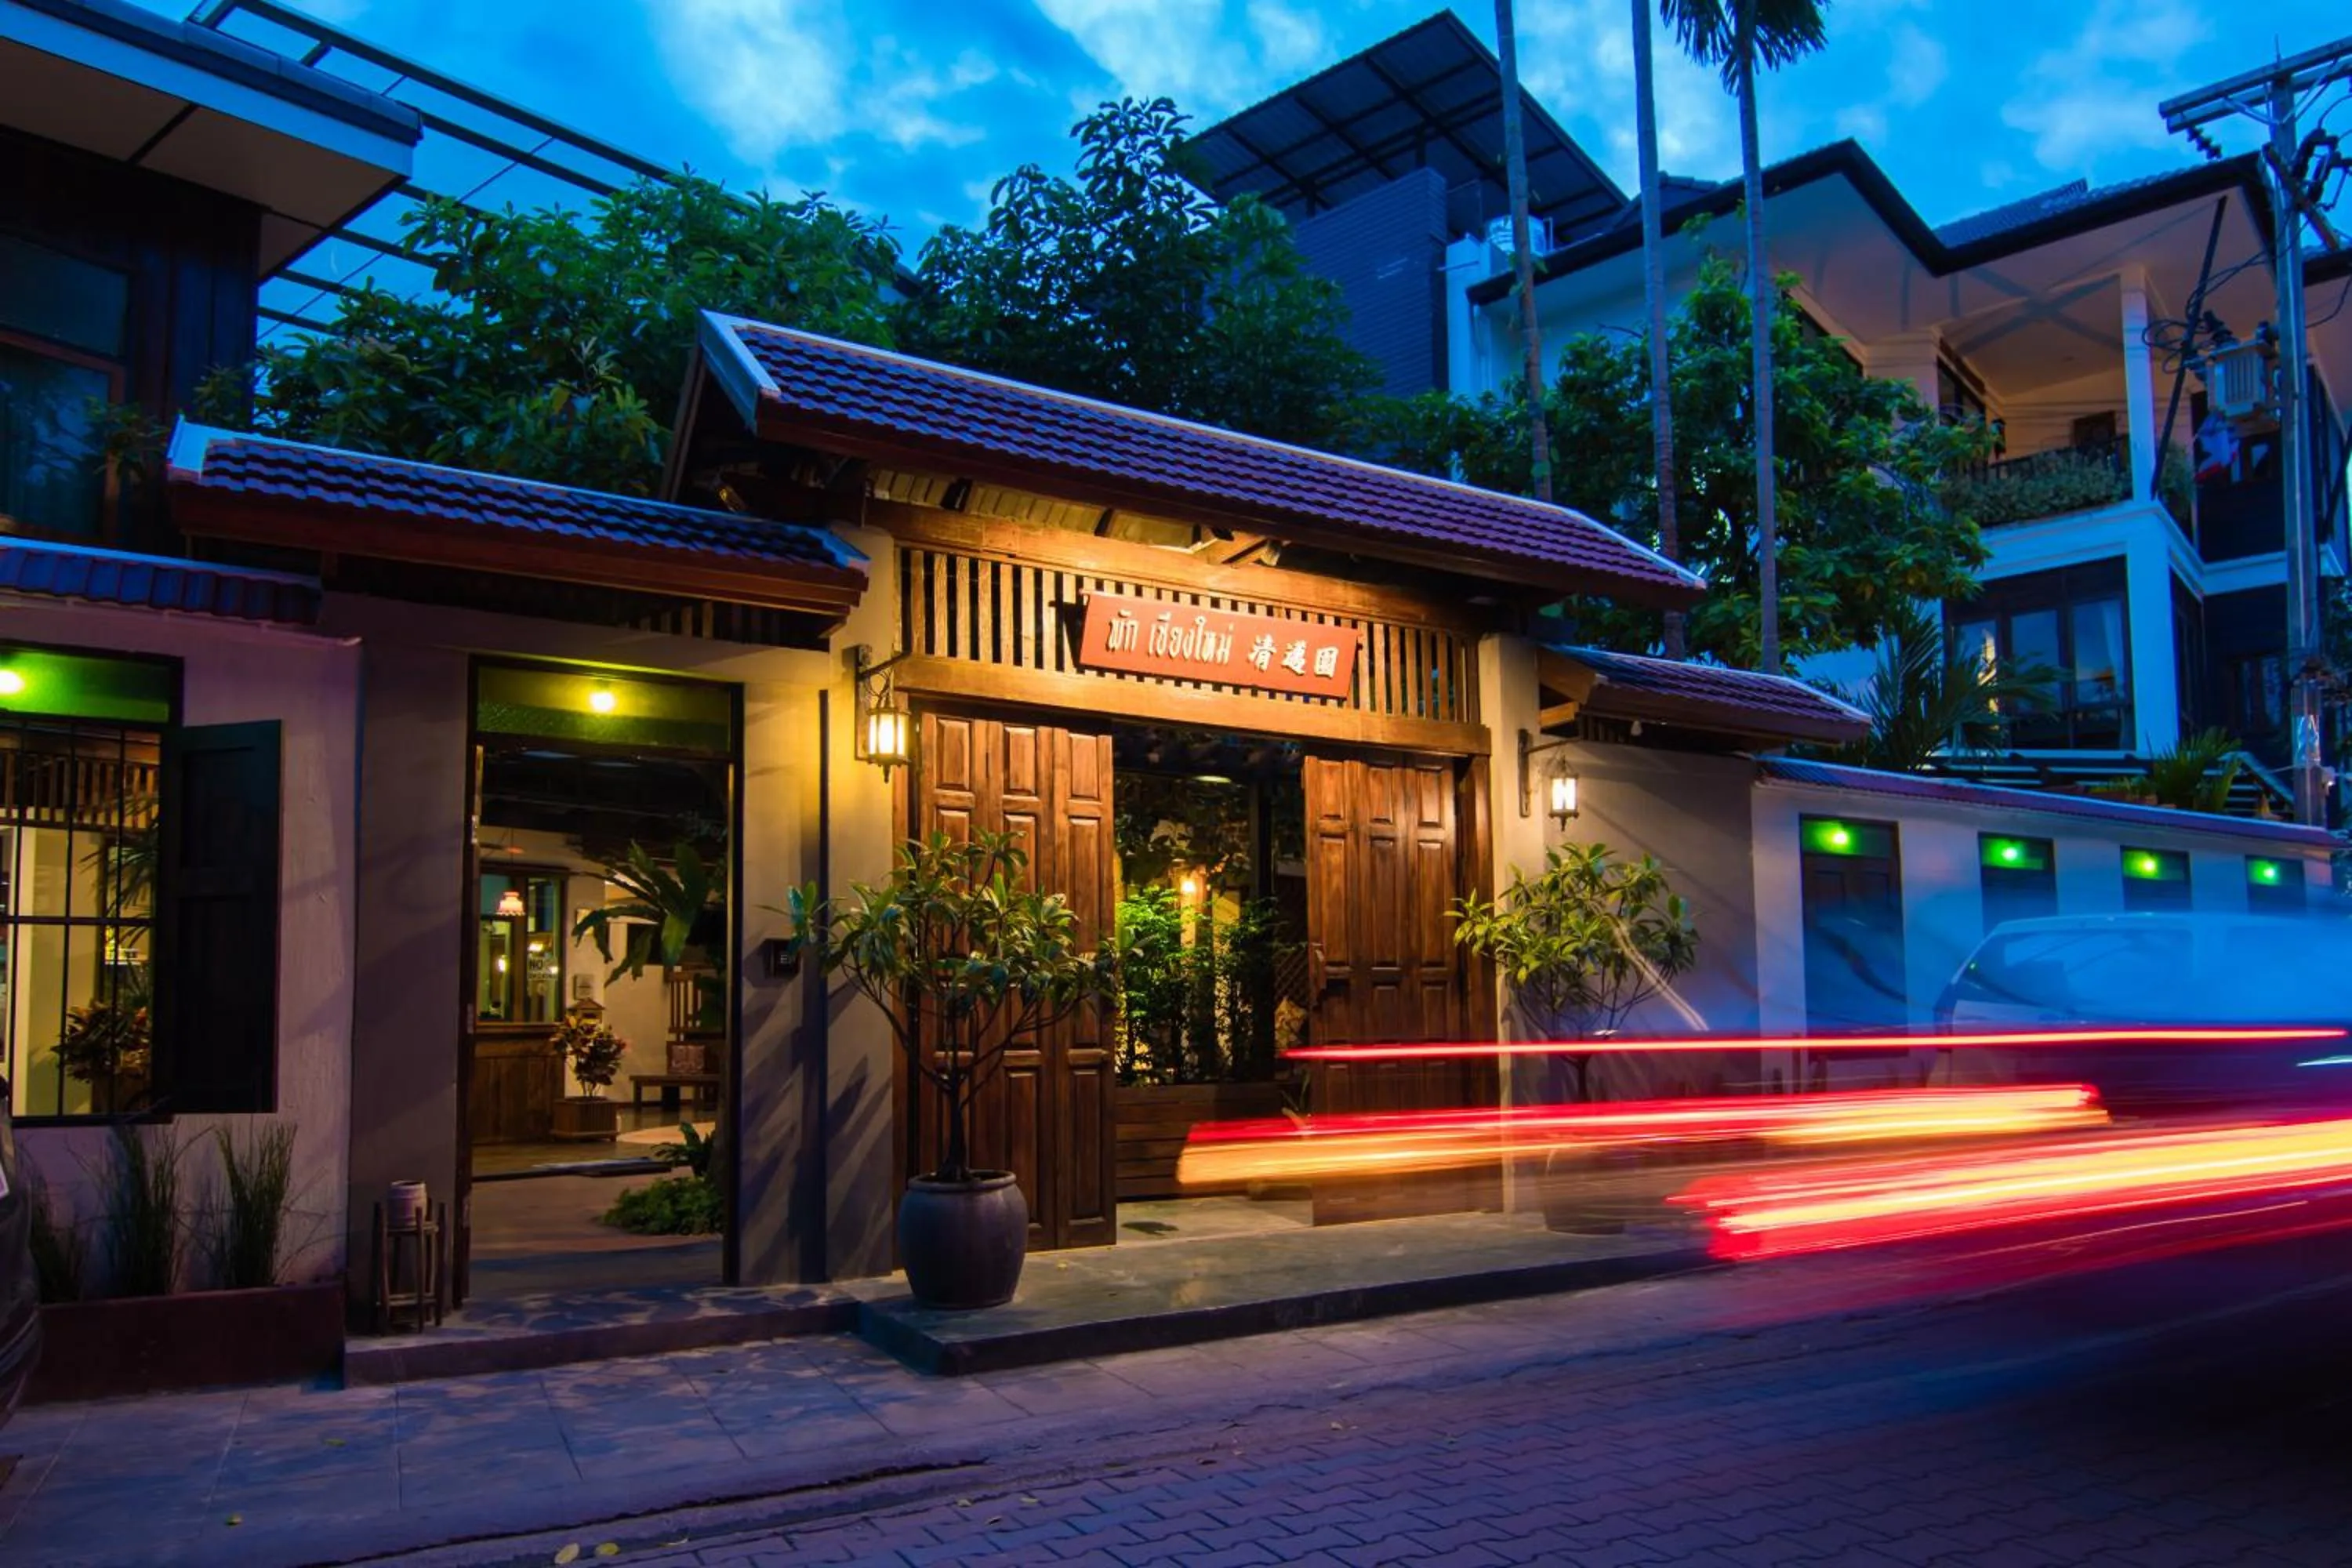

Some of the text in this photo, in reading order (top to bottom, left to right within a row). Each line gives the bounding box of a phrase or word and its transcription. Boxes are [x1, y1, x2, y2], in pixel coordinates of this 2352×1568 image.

[1106, 609, 1234, 665] พัก เชียงใหม่
